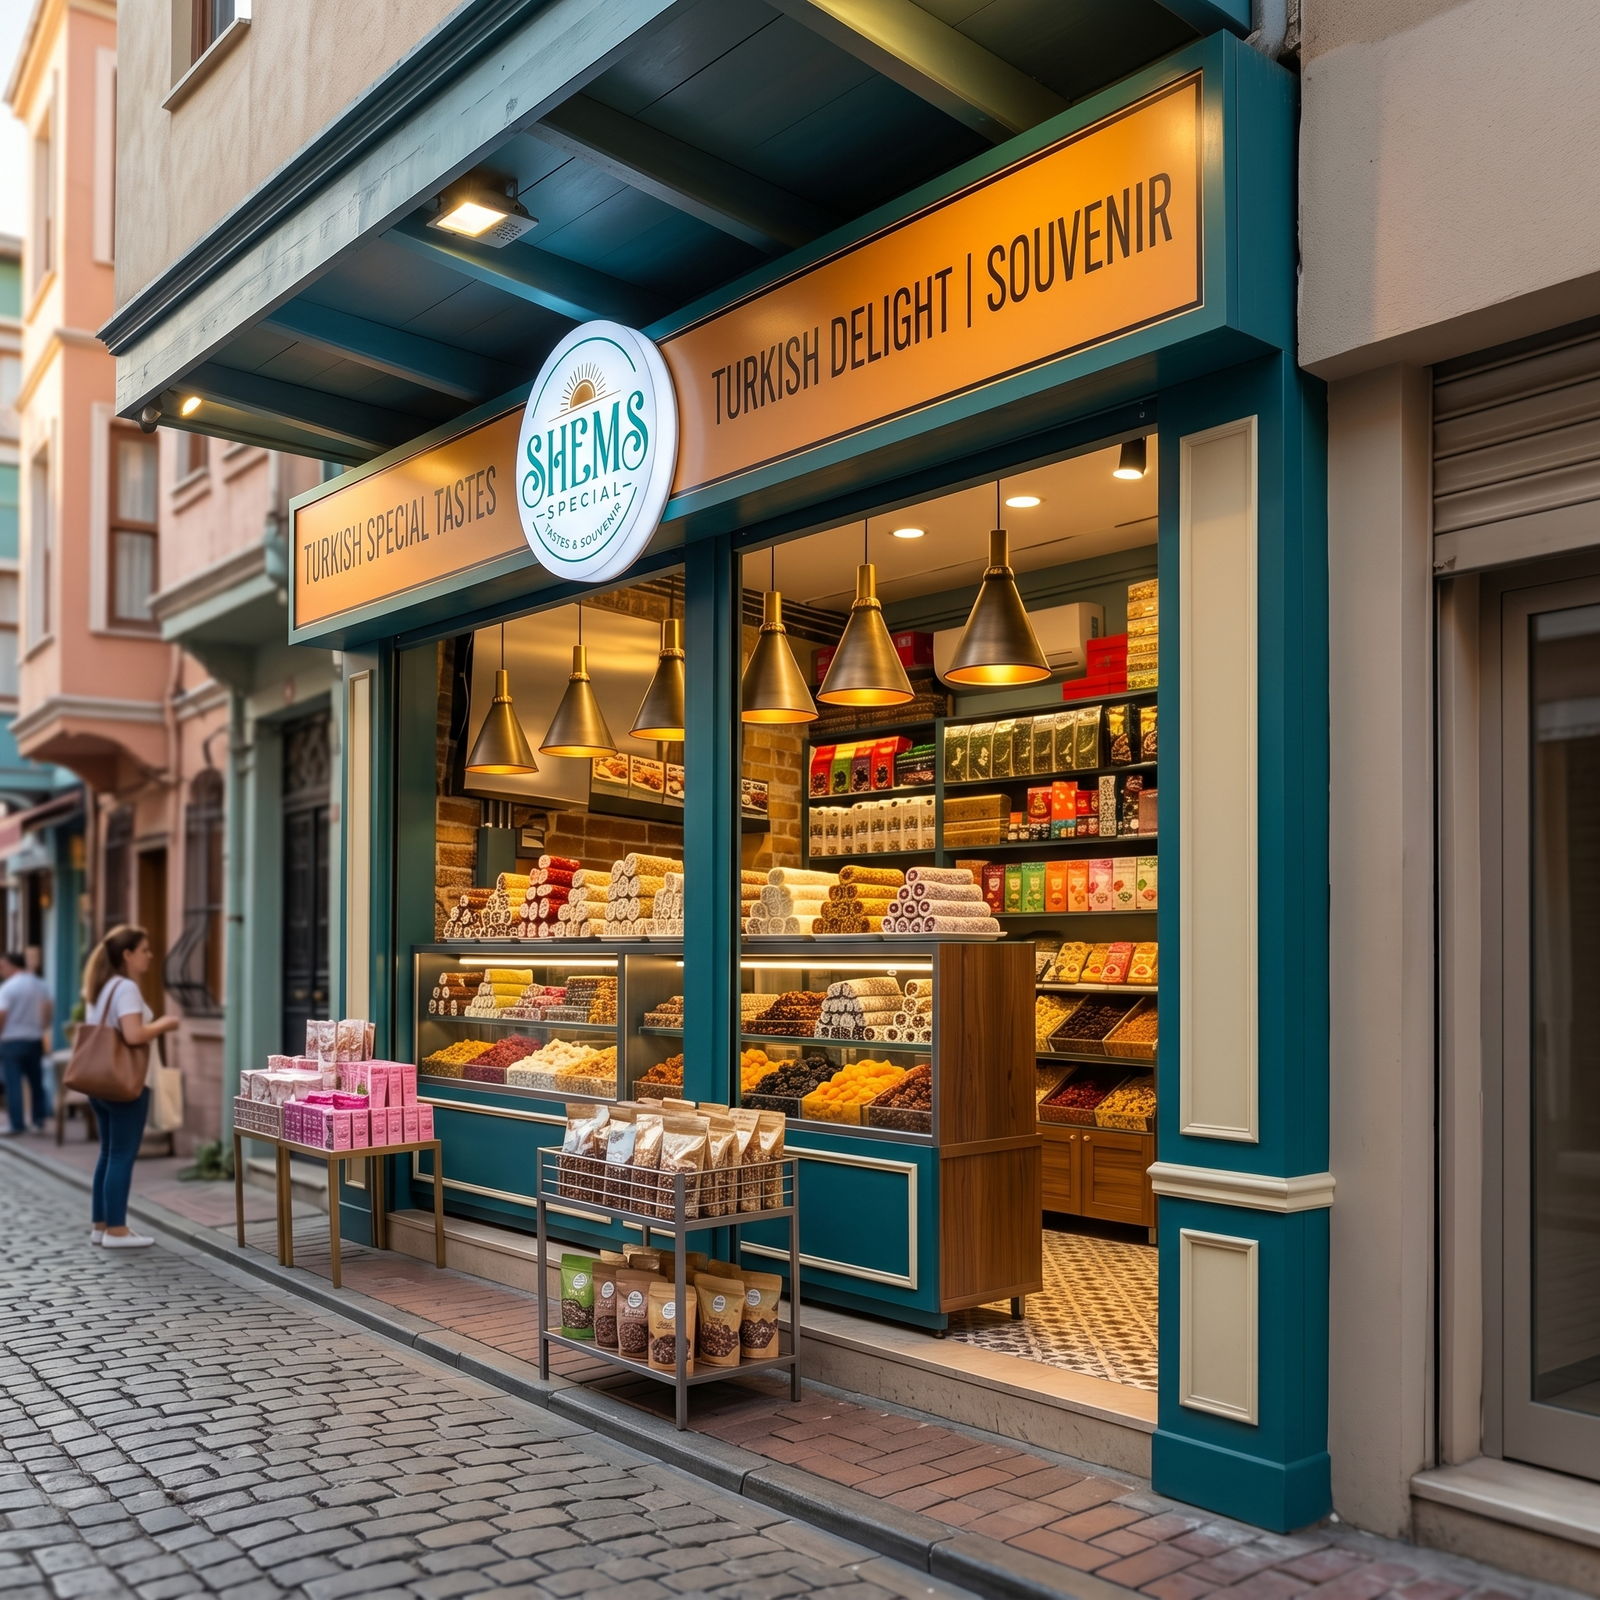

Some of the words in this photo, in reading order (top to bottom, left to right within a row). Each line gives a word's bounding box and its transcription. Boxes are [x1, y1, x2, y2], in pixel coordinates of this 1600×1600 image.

[711, 326, 819, 426] TURKISH
[831, 266, 953, 379] DELIGHT
[986, 172, 1172, 313] SOUVENIR
[521, 390, 649, 508] SHEMS
[304, 527, 362, 585] TURKISH
[366, 496, 430, 562] SPECIAL
[434, 465, 497, 536] TASTES
[544, 522, 571, 550] TASTES
[580, 502, 623, 548] SOUVENIR
